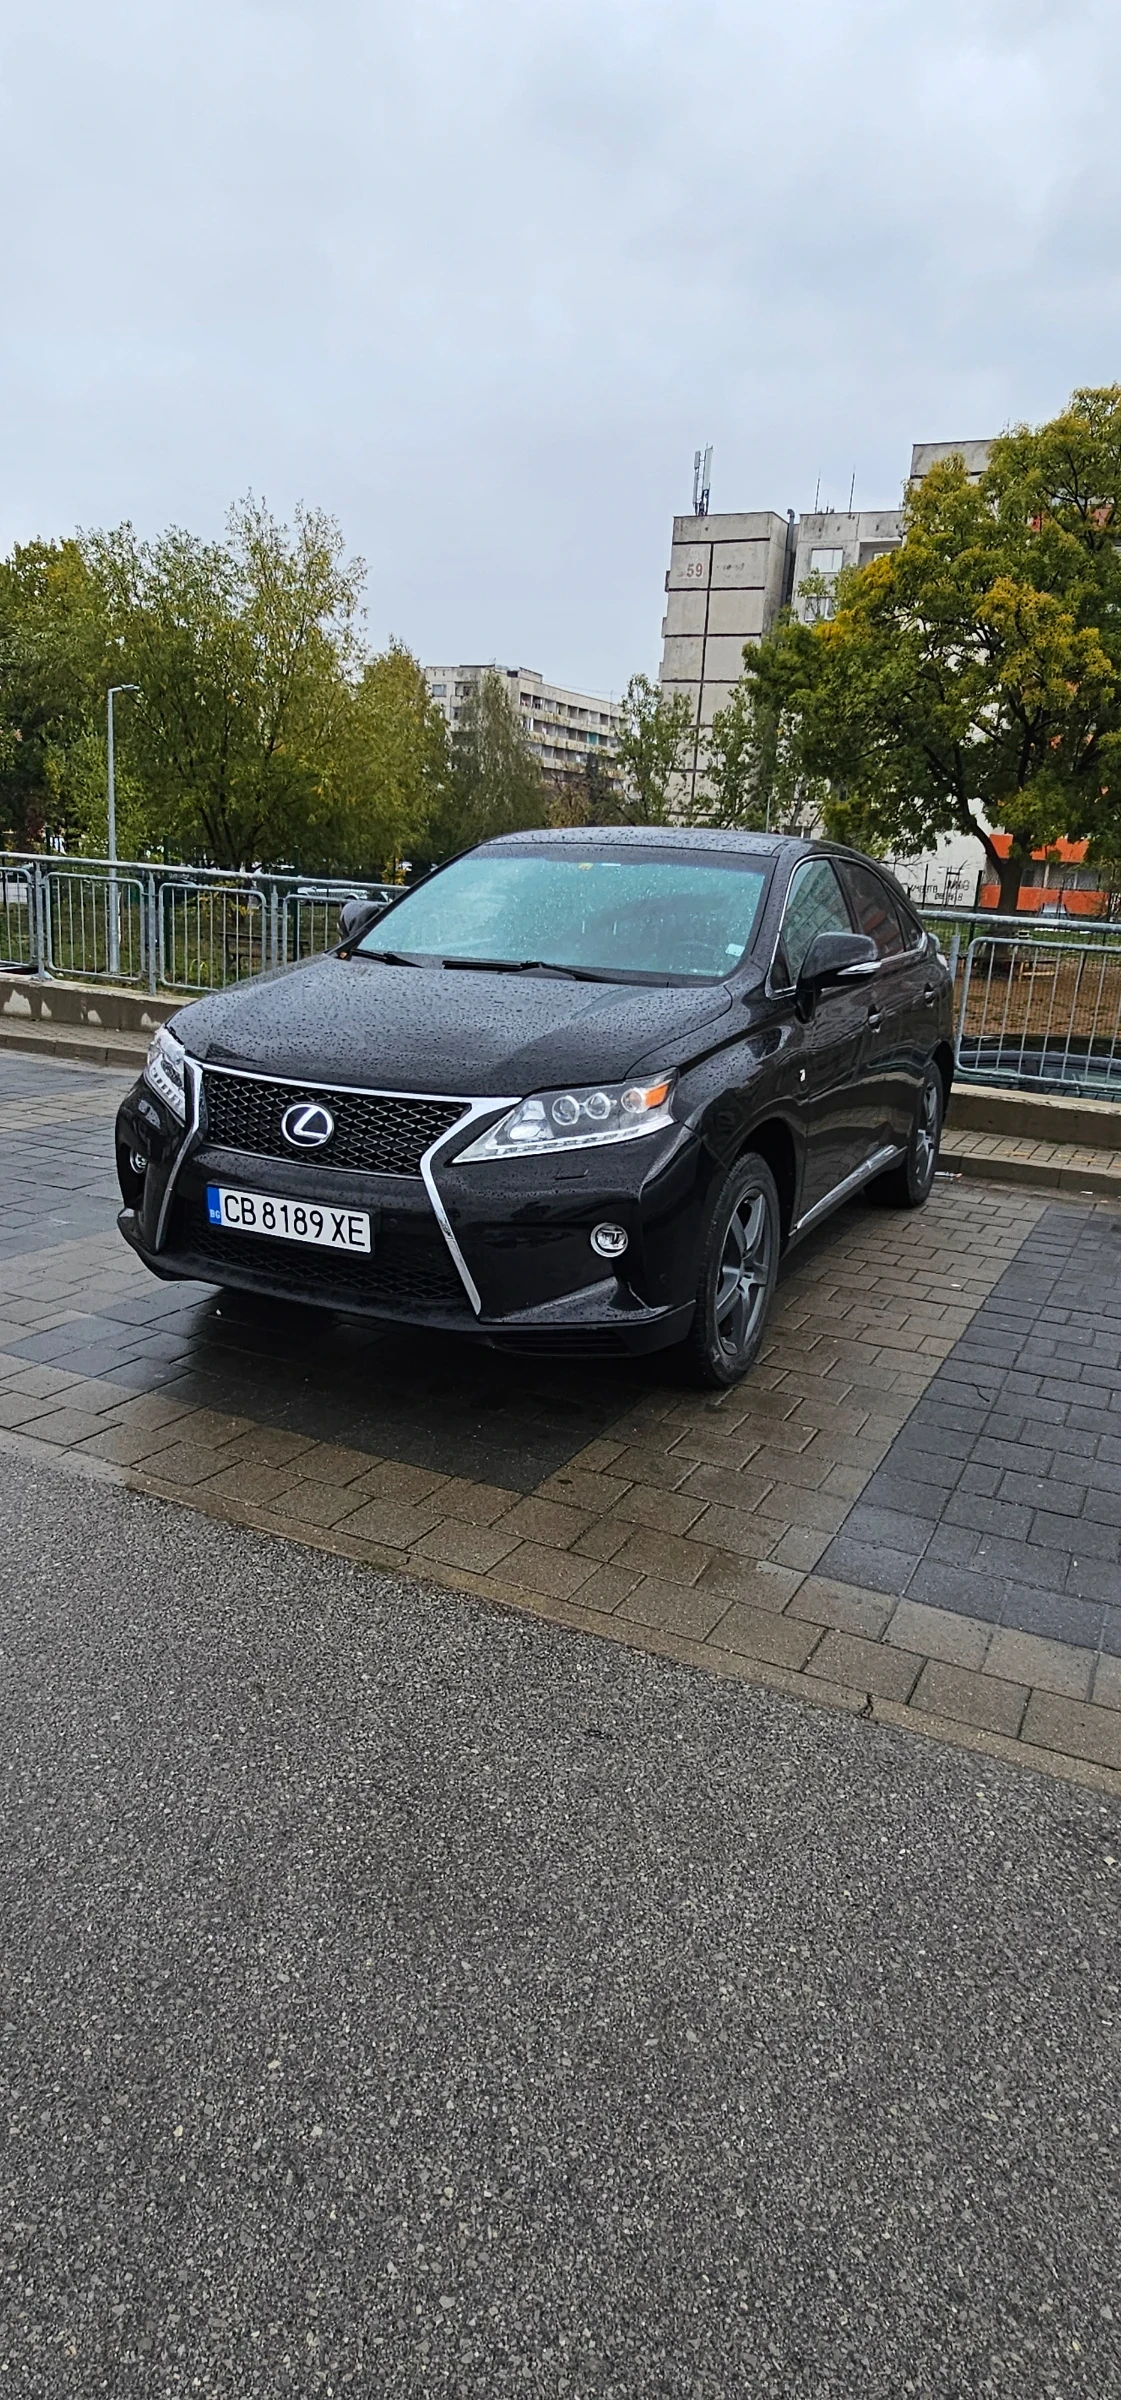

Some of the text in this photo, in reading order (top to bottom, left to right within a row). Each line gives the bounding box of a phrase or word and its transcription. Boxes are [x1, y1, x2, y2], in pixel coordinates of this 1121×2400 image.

[686, 562, 703, 577] 59
[210, 1209, 220, 1219] BG
[225, 1195, 365, 1246] CB 8189 XE
